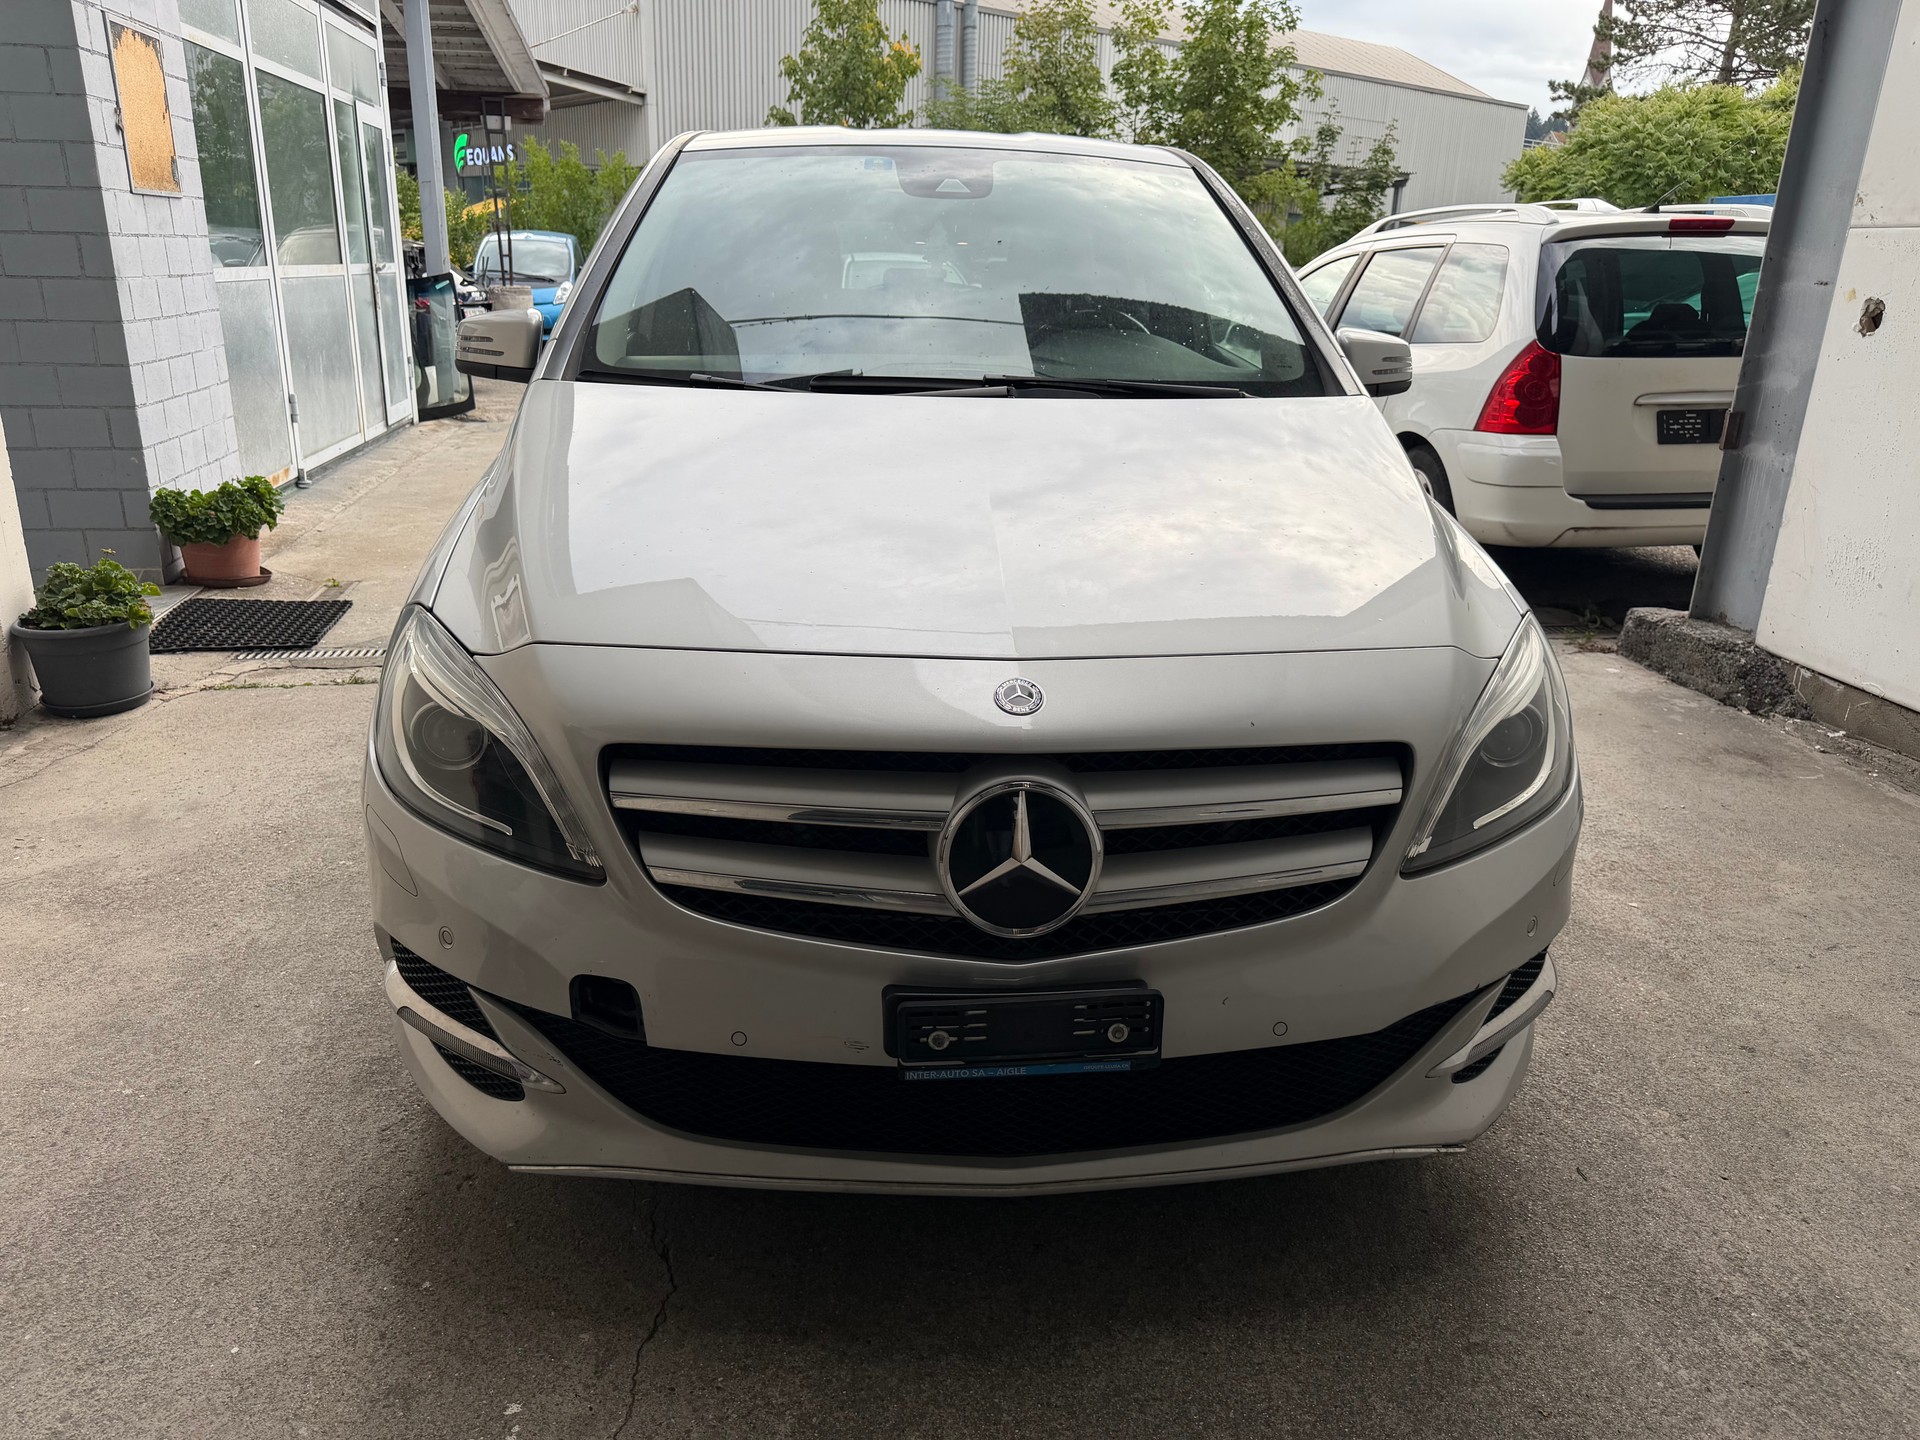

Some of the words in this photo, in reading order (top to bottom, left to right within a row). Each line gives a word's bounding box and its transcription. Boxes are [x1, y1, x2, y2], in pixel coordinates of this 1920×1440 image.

[466, 143, 514, 166] EQUANS
[906, 1069, 969, 1080] INTER-AUTO
[972, 1069, 986, 1077] SA
[997, 1067, 1027, 1076] AIGLE
